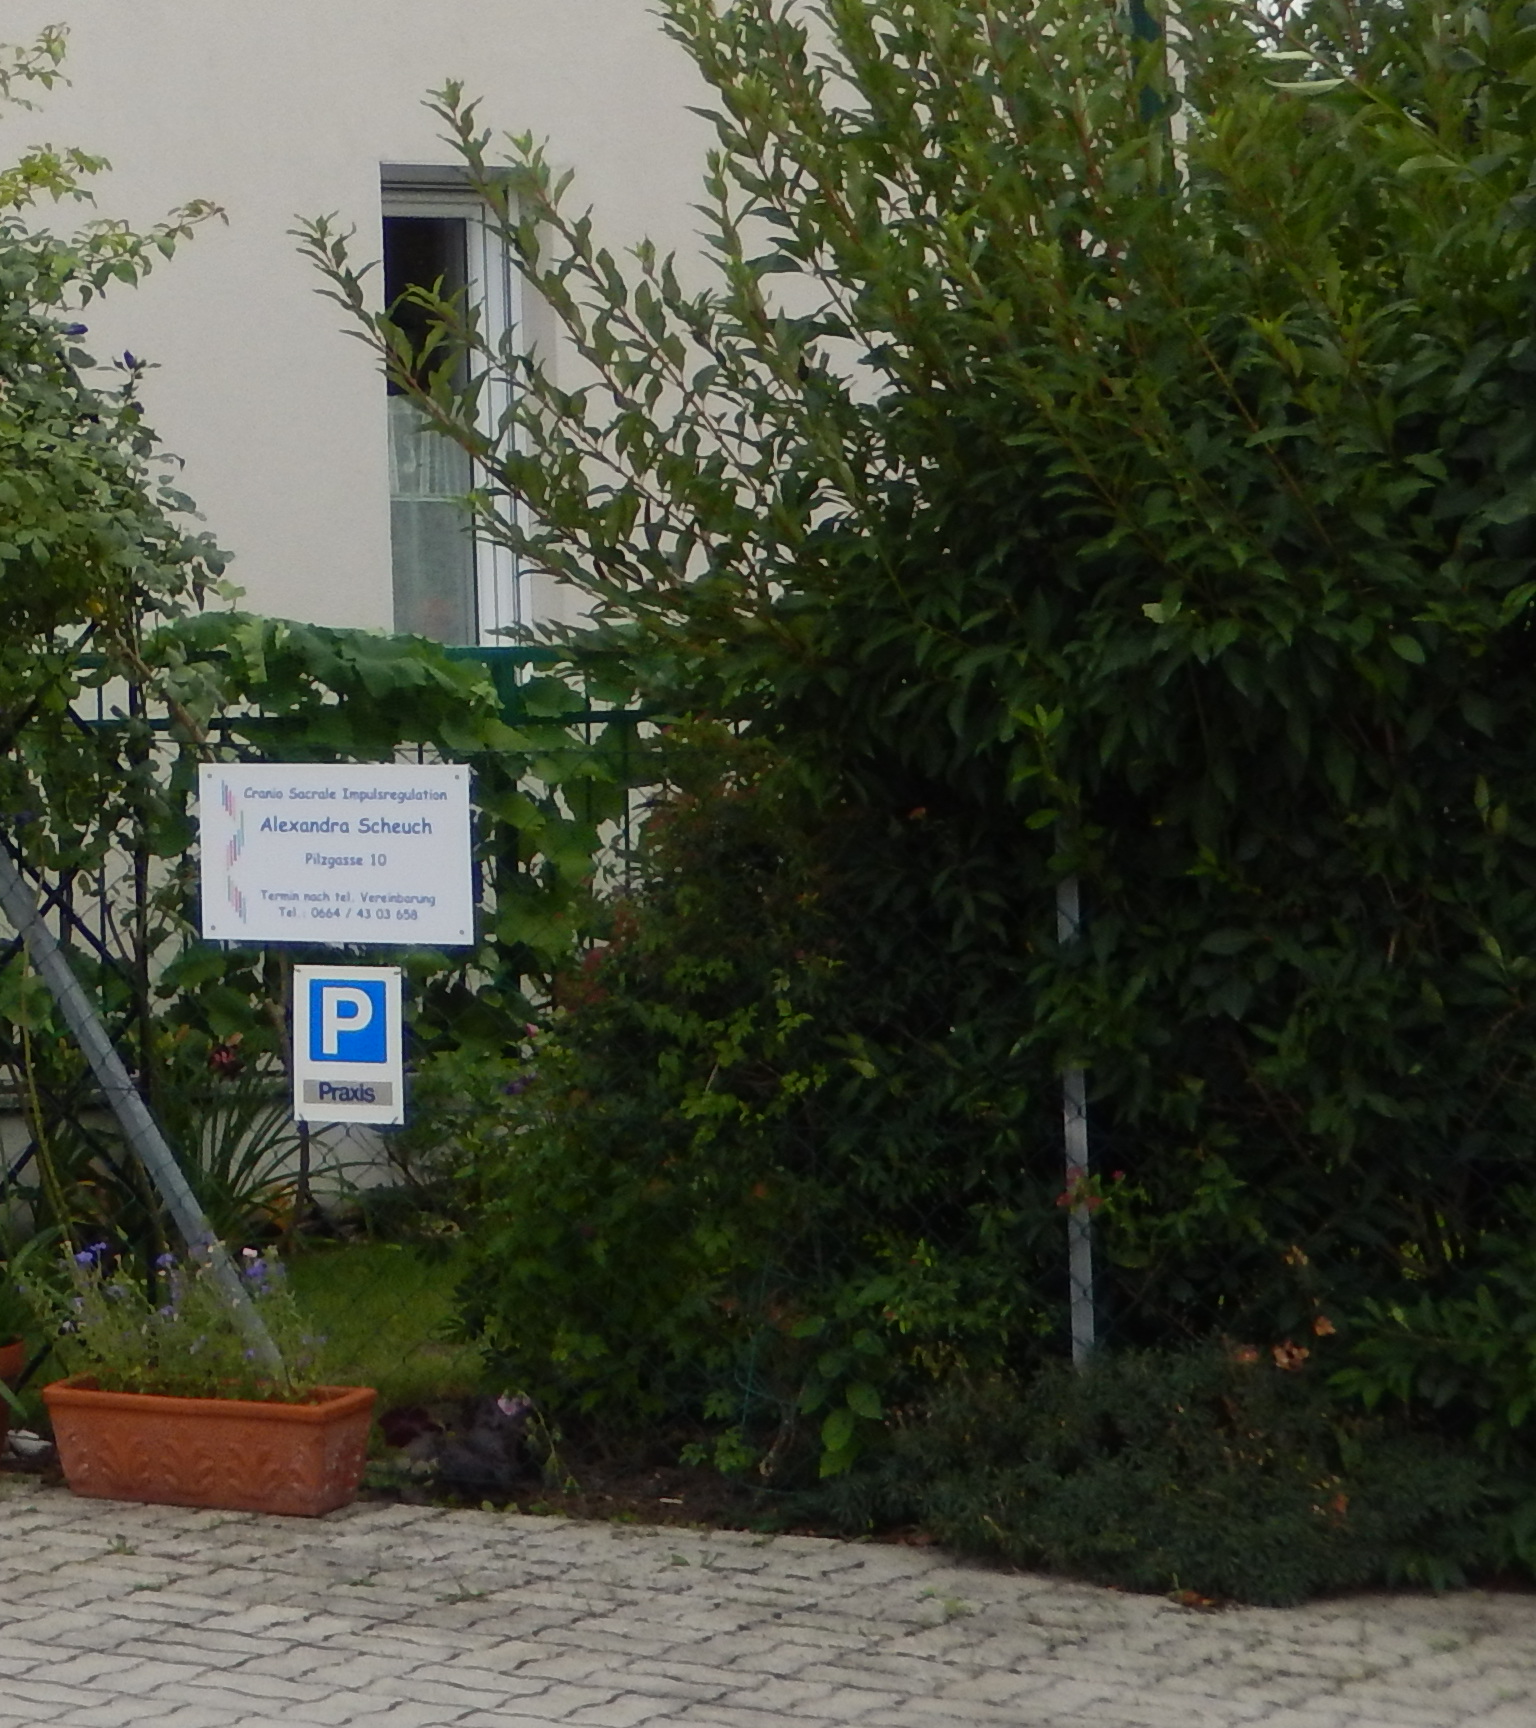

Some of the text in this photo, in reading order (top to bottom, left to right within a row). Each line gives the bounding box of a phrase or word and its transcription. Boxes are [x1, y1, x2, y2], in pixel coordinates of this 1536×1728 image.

[243, 787, 448, 803] Cranio Sacrale Impulsregulation
[260, 816, 432, 834] Alexandra Scheuch
[305, 853, 387, 869] Pilzgasse 10
[261, 890, 436, 907] Termin nach tel. Vereinbarung
[311, 907, 340, 919] 0664
[356, 908, 371, 919] 43
[376, 909, 391, 920] 03
[323, 986, 373, 1055] P
[319, 1081, 376, 1103] Praxis
